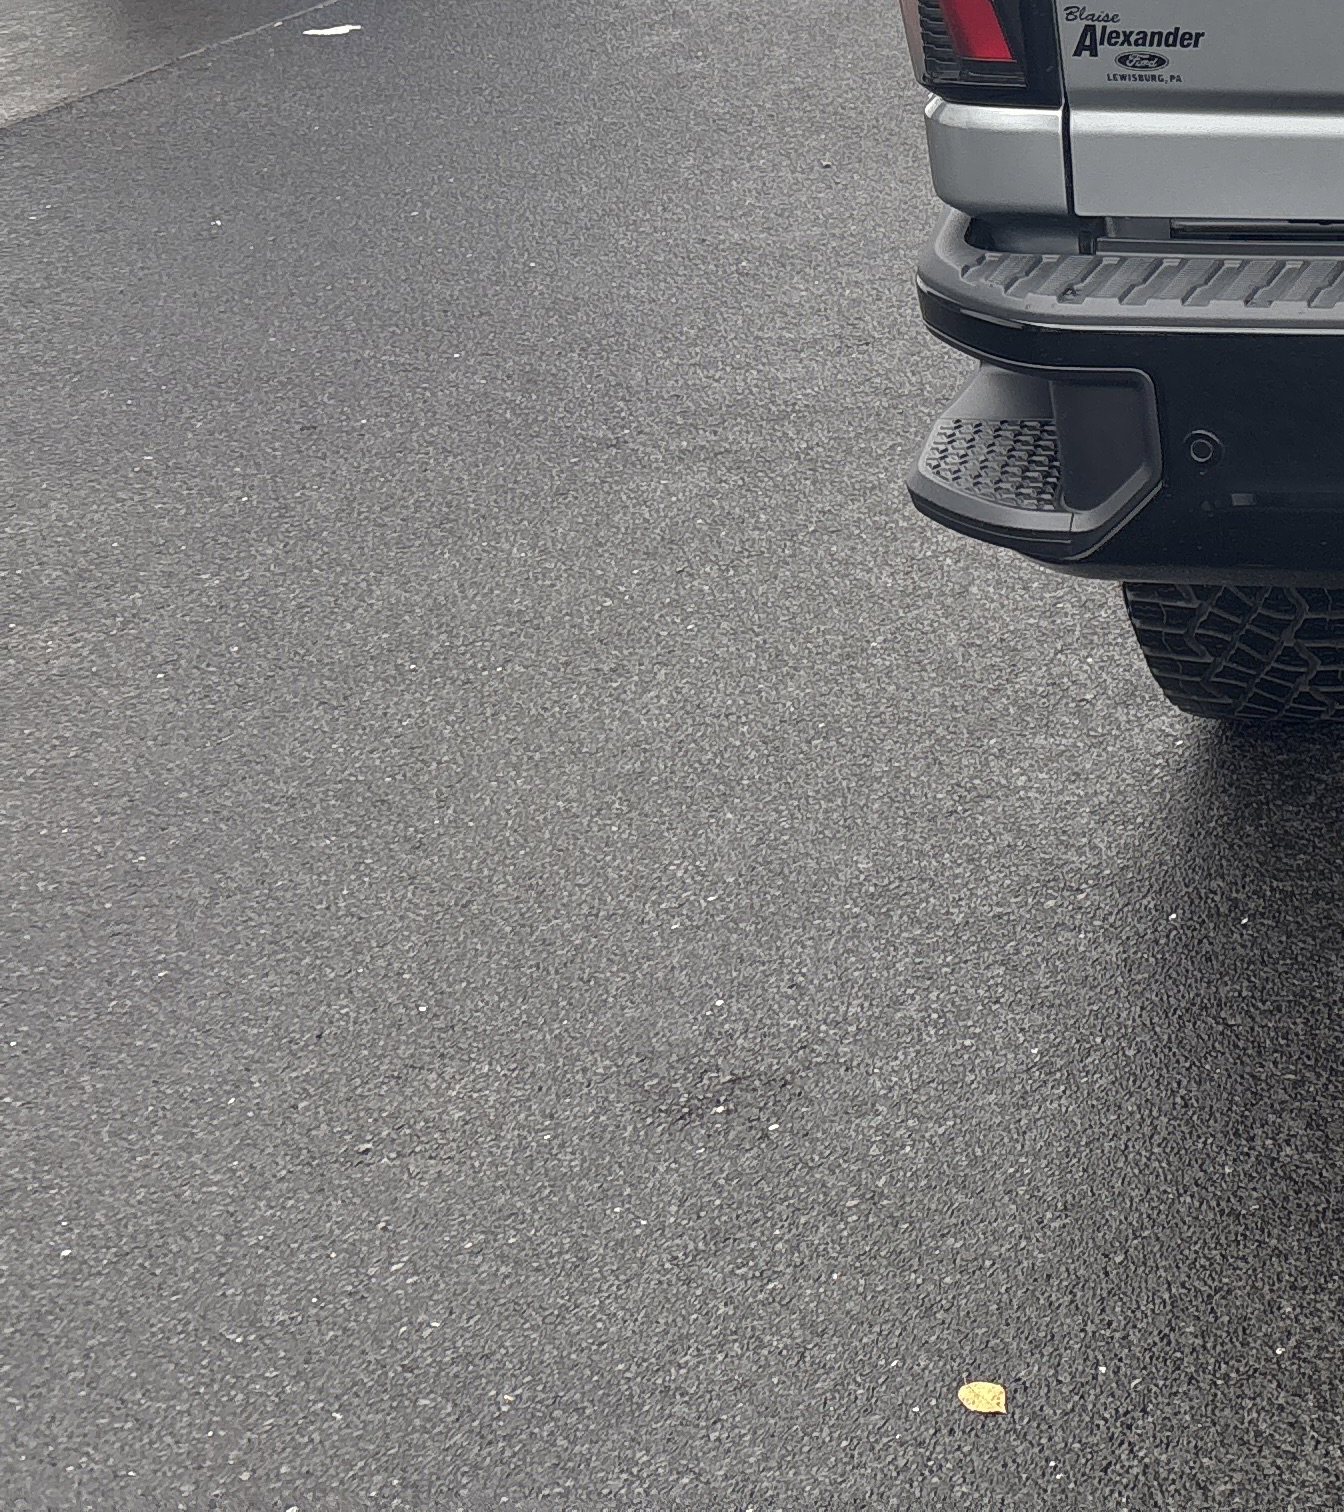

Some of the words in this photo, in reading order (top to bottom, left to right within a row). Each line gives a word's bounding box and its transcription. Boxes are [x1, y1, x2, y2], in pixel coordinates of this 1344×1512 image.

[1063, 5, 1121, 23] Blaise
[1072, 24, 1206, 58] Alexander
[1106, 73, 1168, 84] LEWISBURG,
[1169, 74, 1183, 83] PA
